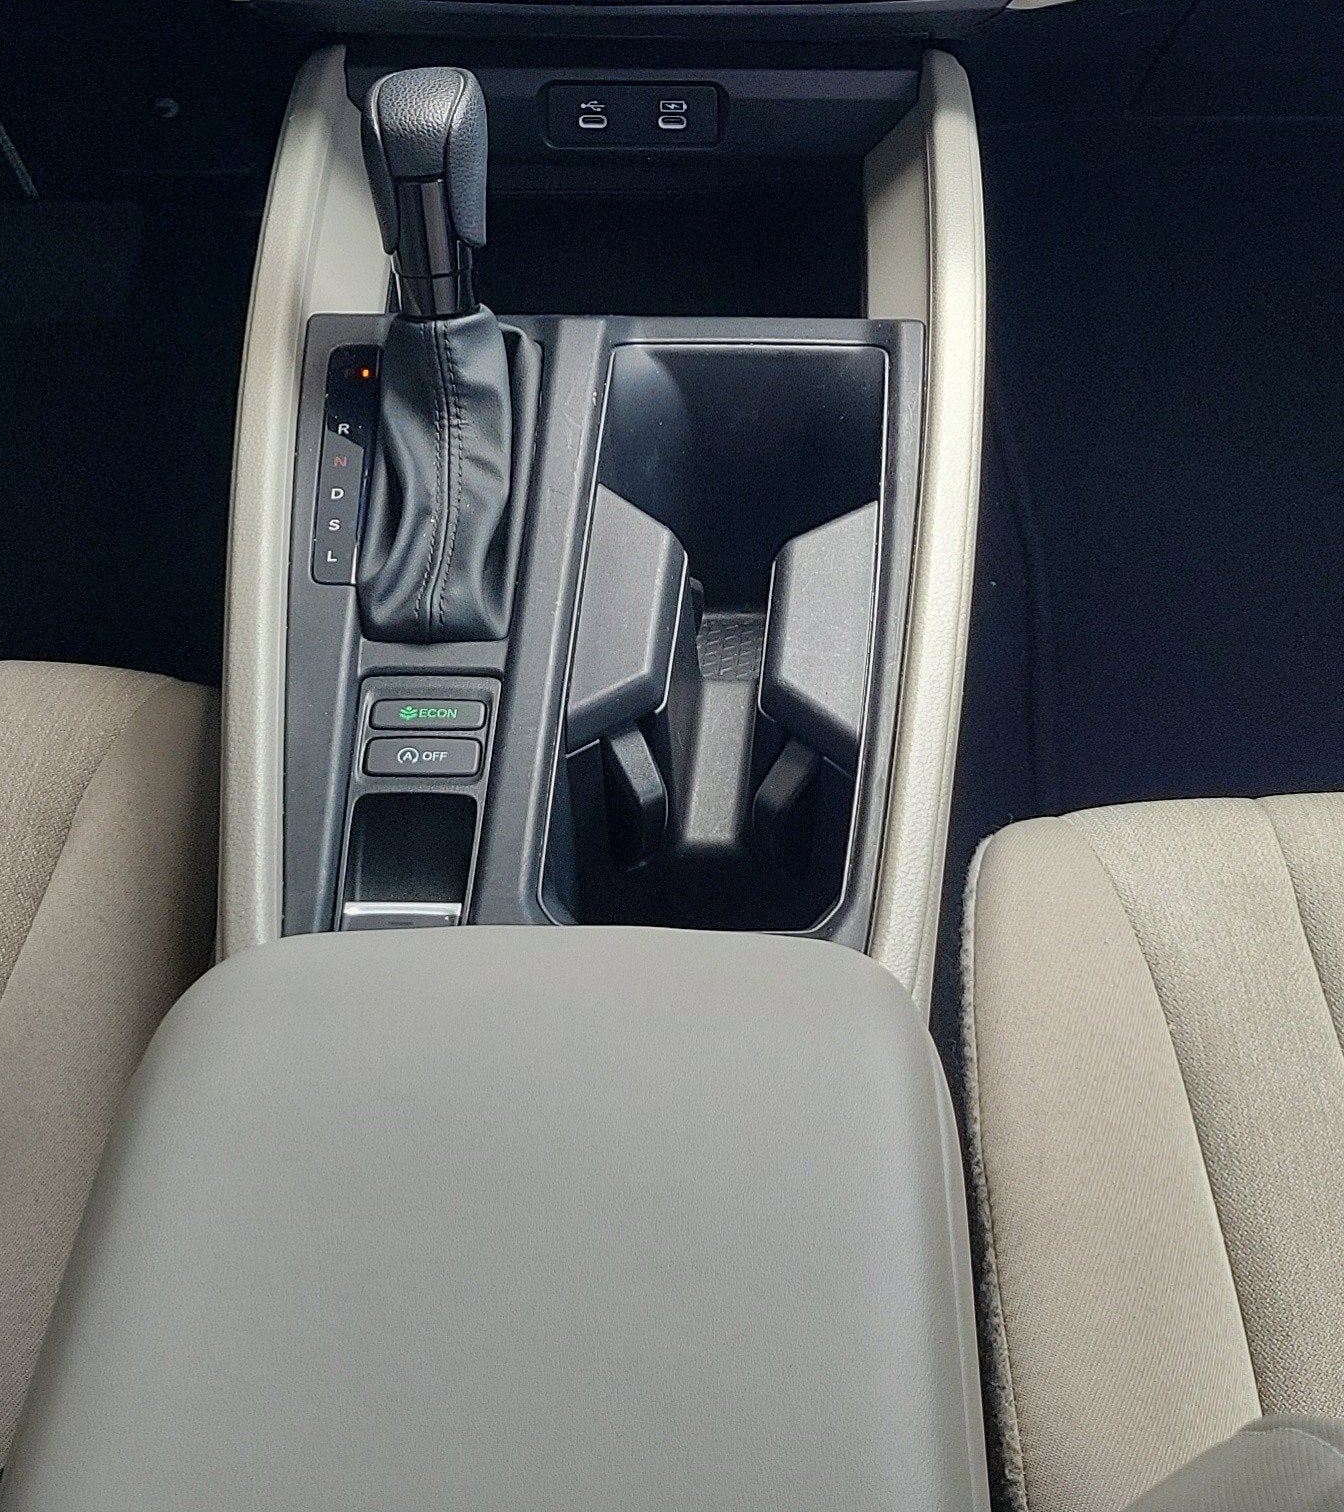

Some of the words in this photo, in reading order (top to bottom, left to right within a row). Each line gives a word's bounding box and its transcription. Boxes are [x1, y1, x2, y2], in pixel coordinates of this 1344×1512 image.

[338, 423, 350, 434] R
[333, 456, 347, 467] N
[331, 488, 344, 500] D
[328, 519, 340, 531] S
[327, 550, 338, 562] L
[419, 708, 457, 718] ECON
[422, 751, 448, 761] OFF
